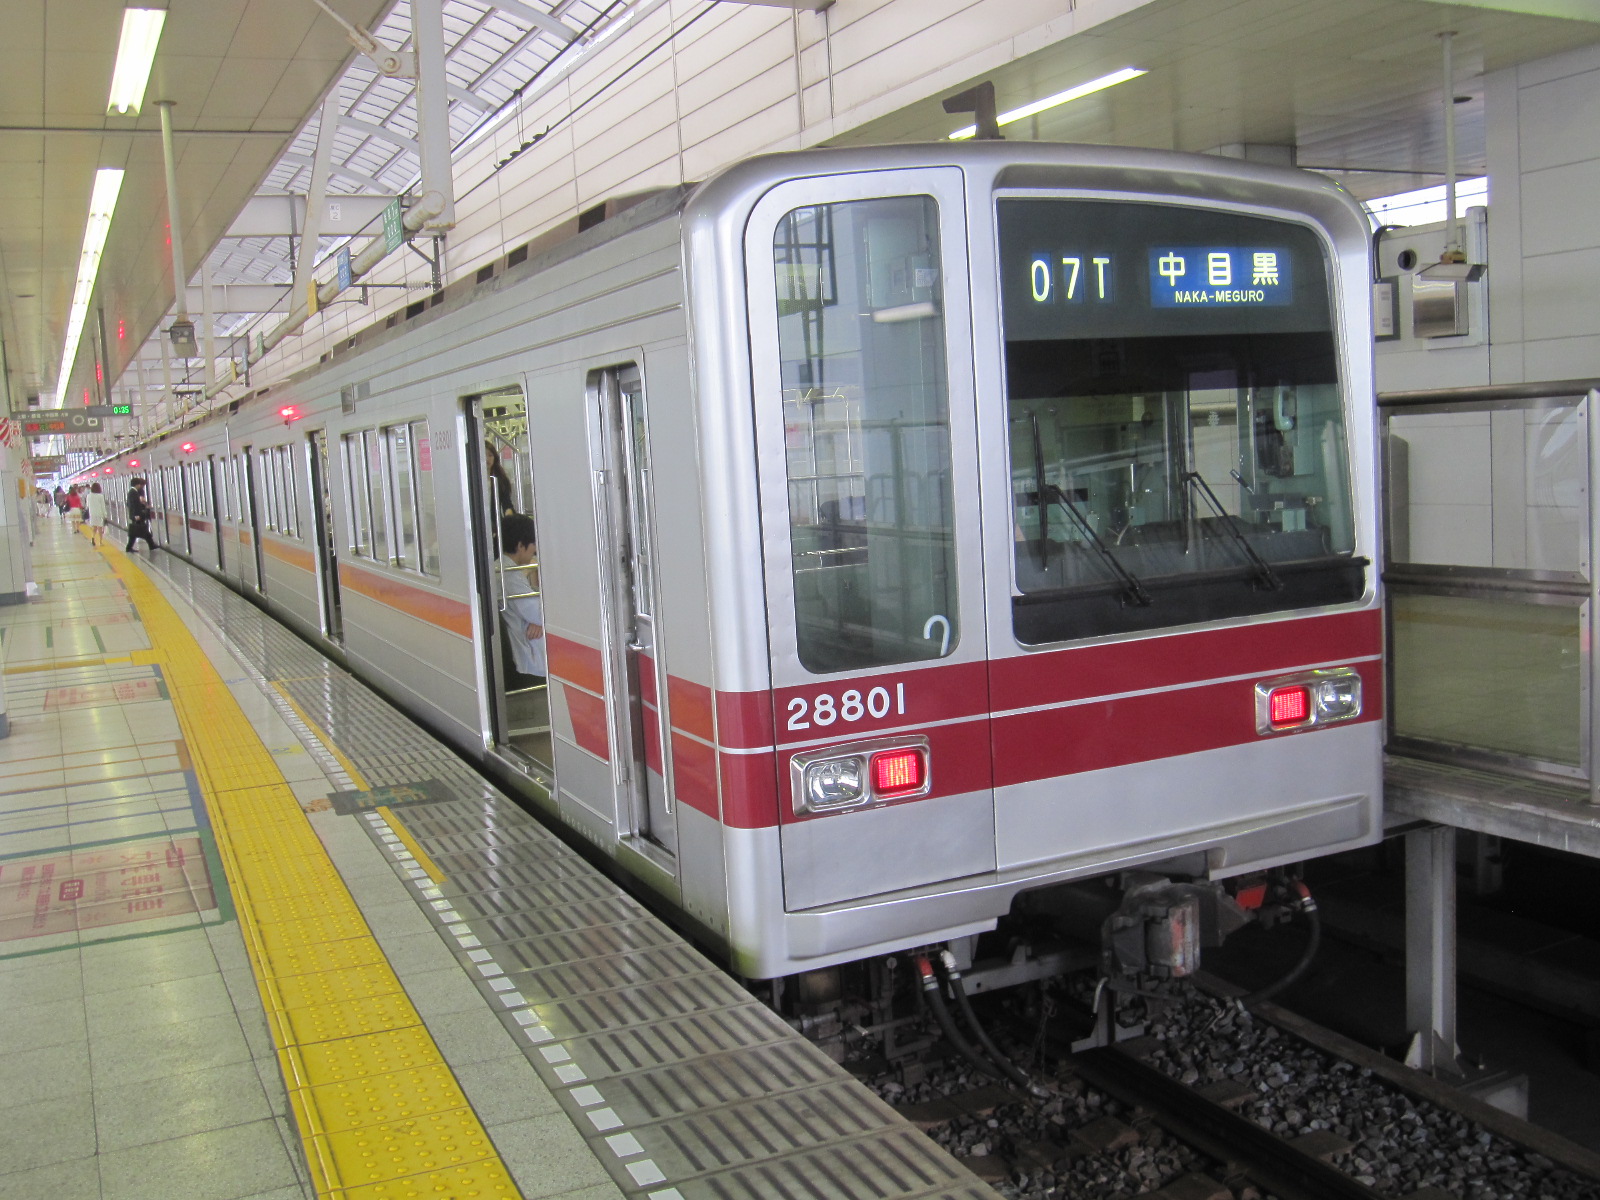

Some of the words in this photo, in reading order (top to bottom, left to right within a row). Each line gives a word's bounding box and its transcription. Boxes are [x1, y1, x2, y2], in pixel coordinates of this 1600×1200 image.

[1031, 257, 1110, 302] 07T
[1158, 252, 1279, 286] 中目黒
[1175, 290, 1265, 303] NAKA-MEGURO
[787, 683, 905, 731] 28801
